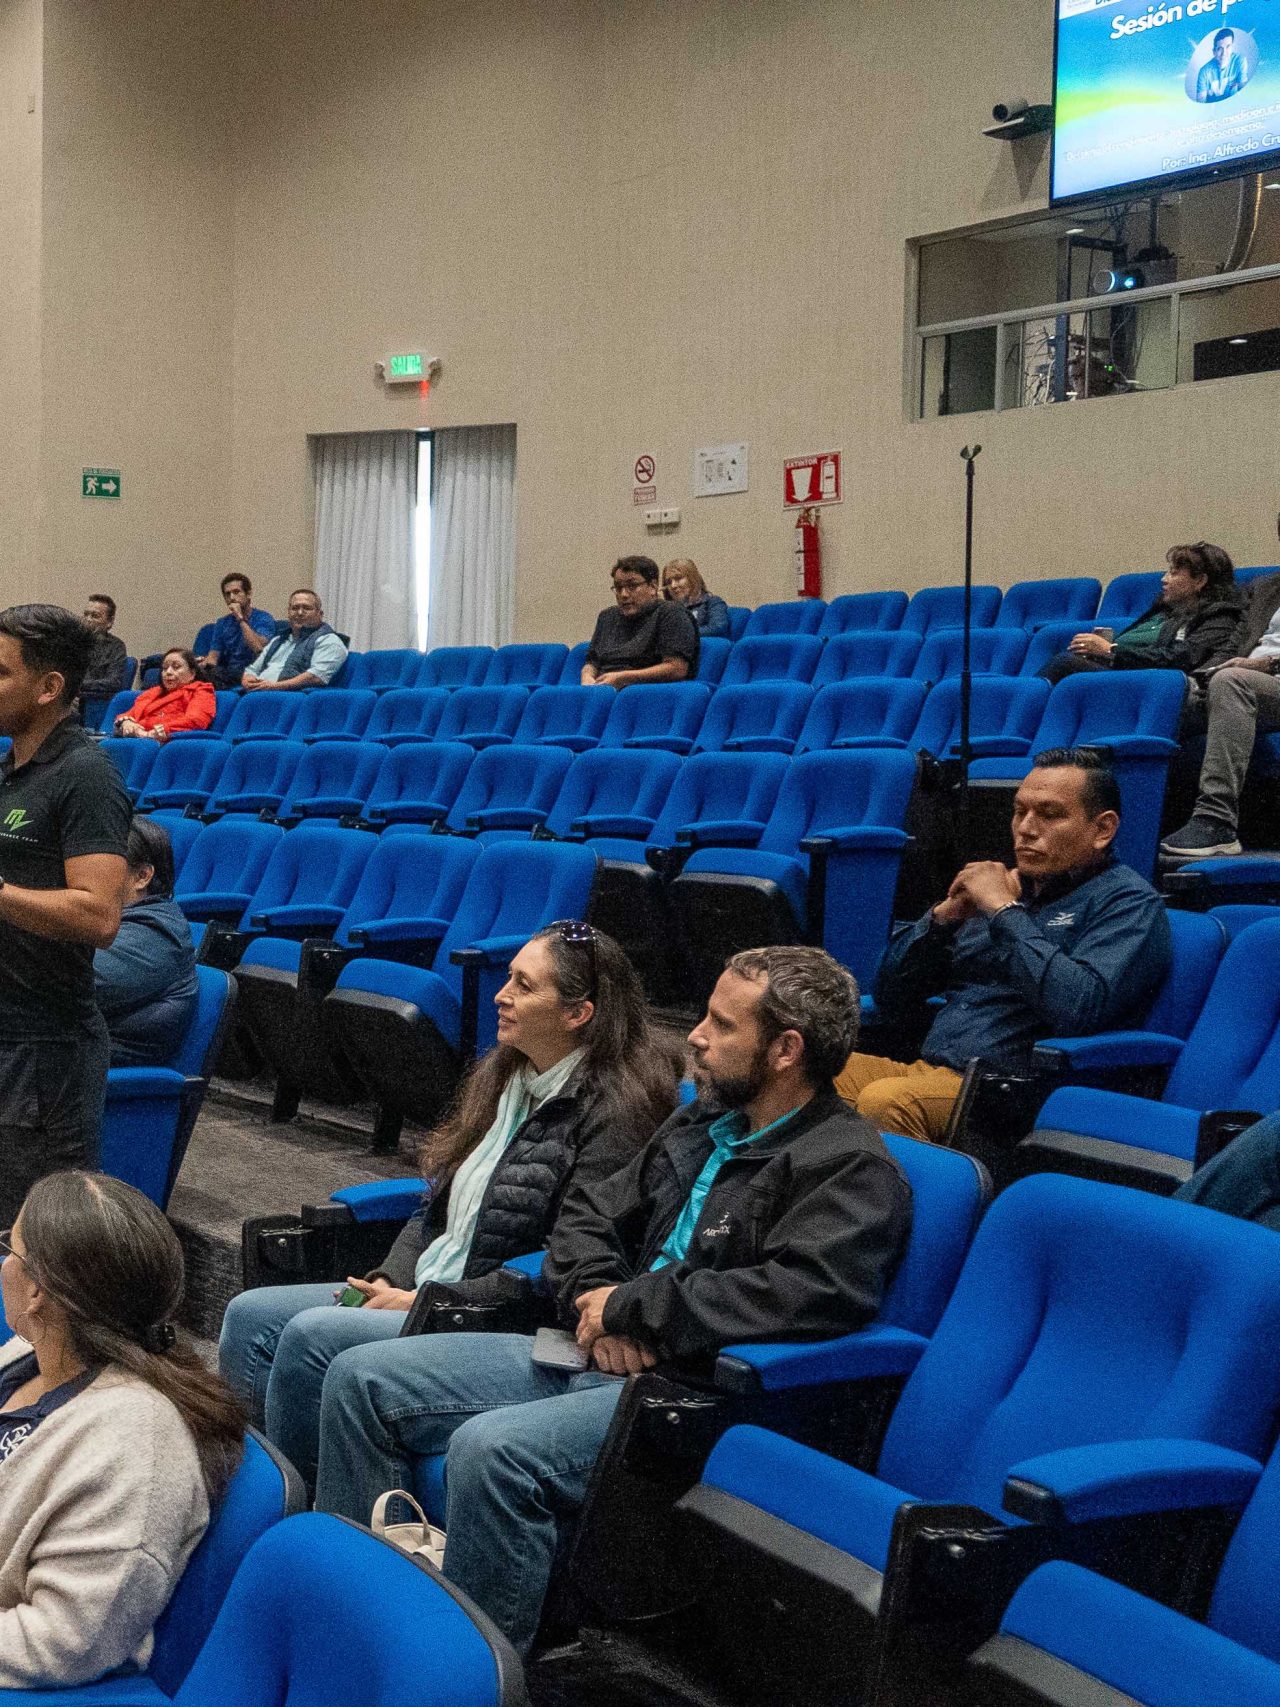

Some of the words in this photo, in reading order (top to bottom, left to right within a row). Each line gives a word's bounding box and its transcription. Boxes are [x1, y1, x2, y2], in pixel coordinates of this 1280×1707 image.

[1109, 3, 1182, 39] Sesión
[1162, 158, 1186, 170] Por:
[1188, 152, 1211, 165] Ing.
[1214, 138, 1259, 158] Alfredo
[391, 354, 422, 375] SALIDA
